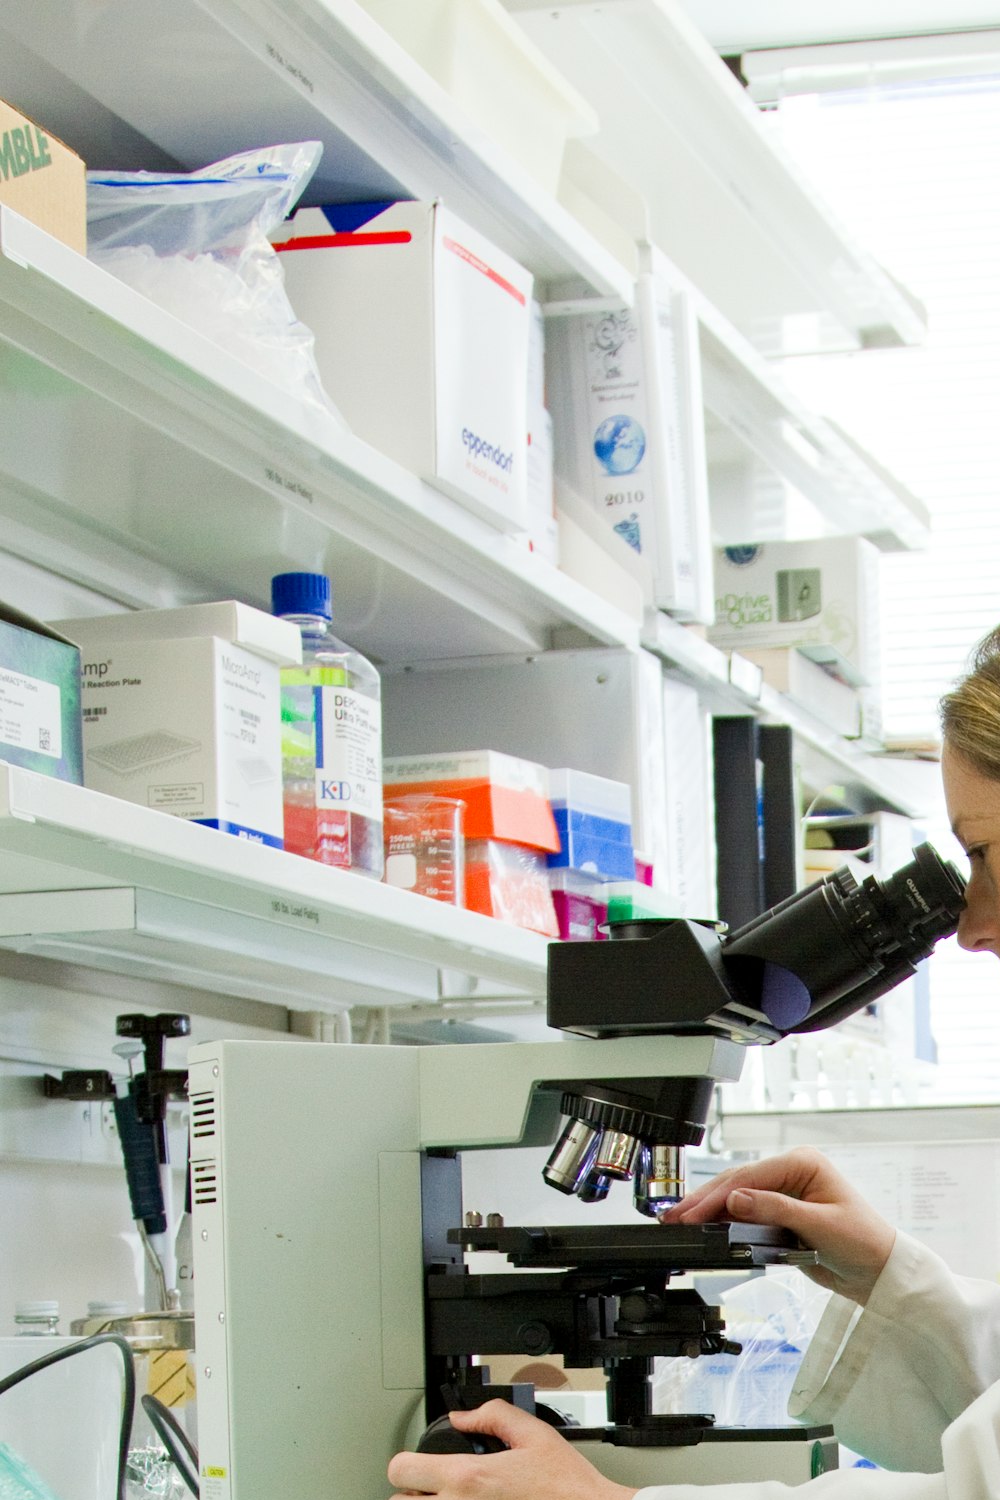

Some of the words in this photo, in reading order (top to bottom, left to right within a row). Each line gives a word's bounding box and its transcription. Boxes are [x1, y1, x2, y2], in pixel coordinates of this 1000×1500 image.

[462, 427, 513, 474] eppendorf
[605, 490, 645, 507] 2010
[727, 604, 772, 629] Quad
[87, 680, 121, 689] Reaction
[122, 678, 142, 686] Plate
[428, 846, 438, 854] 50
[425, 867, 438, 875] 100
[906, 878, 931, 913] OLYMPUS
[303, 907, 319, 924] Rating
[86, 1078, 93, 1092] 3
